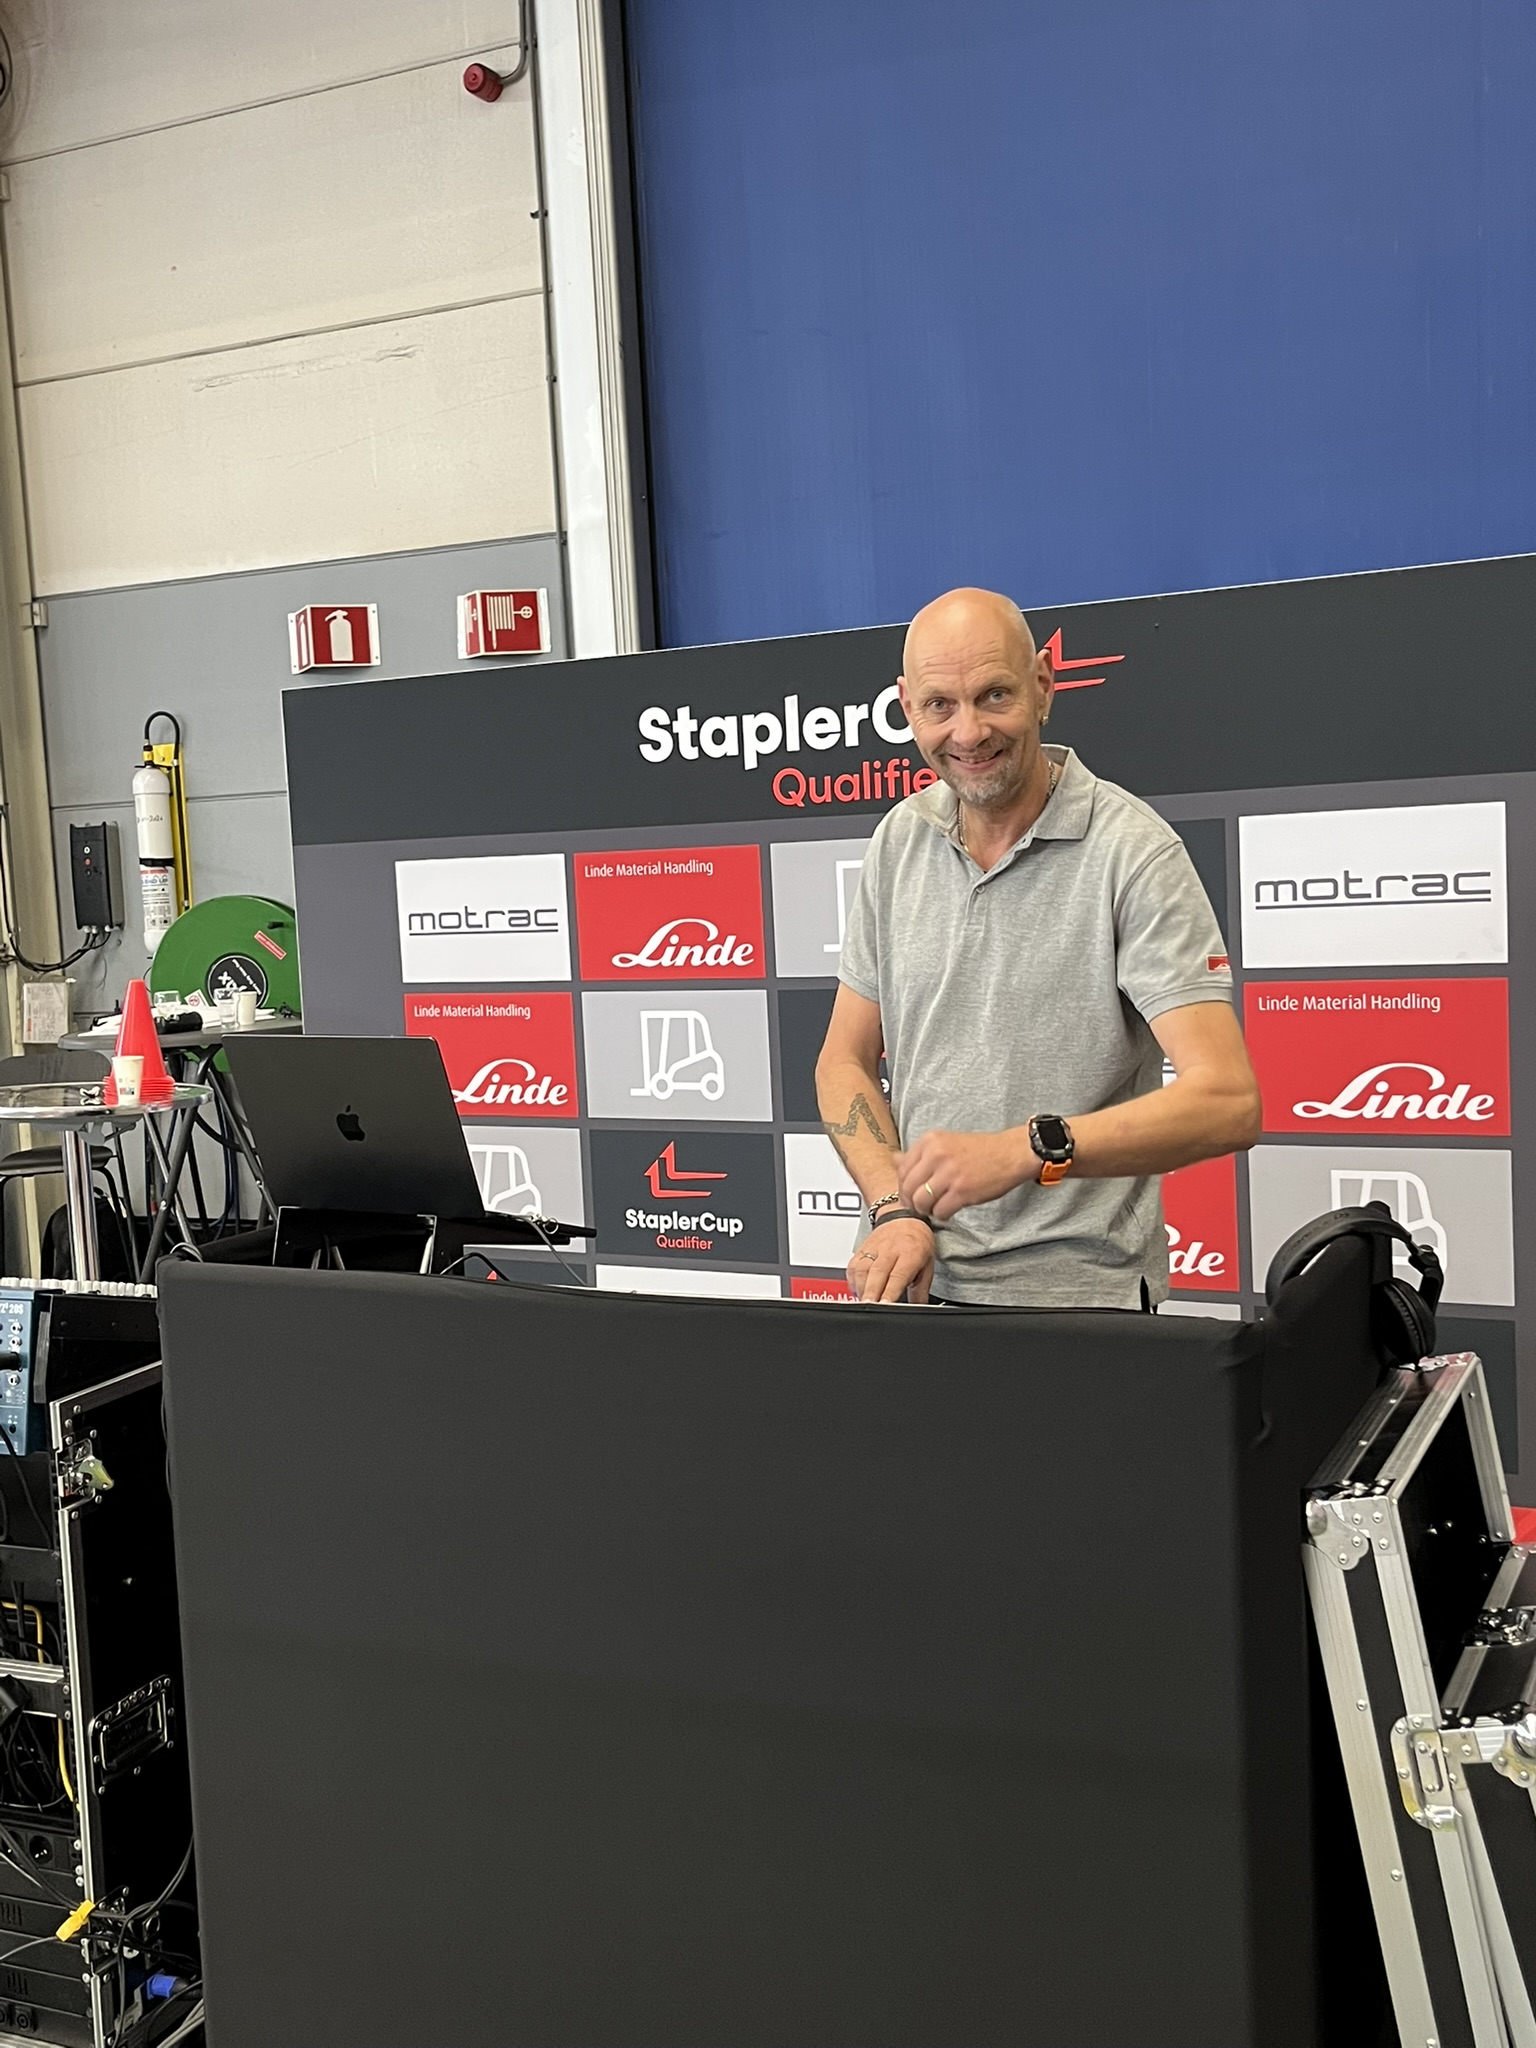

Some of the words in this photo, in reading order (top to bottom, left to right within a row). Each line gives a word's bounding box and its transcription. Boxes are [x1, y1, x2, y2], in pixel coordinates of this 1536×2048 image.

[638, 684, 917, 771] StaplerC
[772, 758, 940, 807] Qualifie
[584, 863, 614, 878] Linde
[616, 861, 662, 877] Material
[664, 859, 714, 876] Handling
[1255, 870, 1492, 903] motrac
[408, 905, 559, 932] motrac
[611, 918, 754, 968] Linde
[414, 1004, 441, 1018] Linde
[442, 1003, 484, 1018] Material
[485, 1003, 531, 1020] Handling
[1258, 995, 1299, 1012] Linde
[1302, 993, 1367, 1011] Material
[1371, 992, 1441, 1013] Handling
[451, 1058, 569, 1106] Linde
[1292, 1062, 1495, 1121] Linde
[625, 1208, 744, 1238] StaplerCup
[656, 1234, 713, 1251] Qualifier
